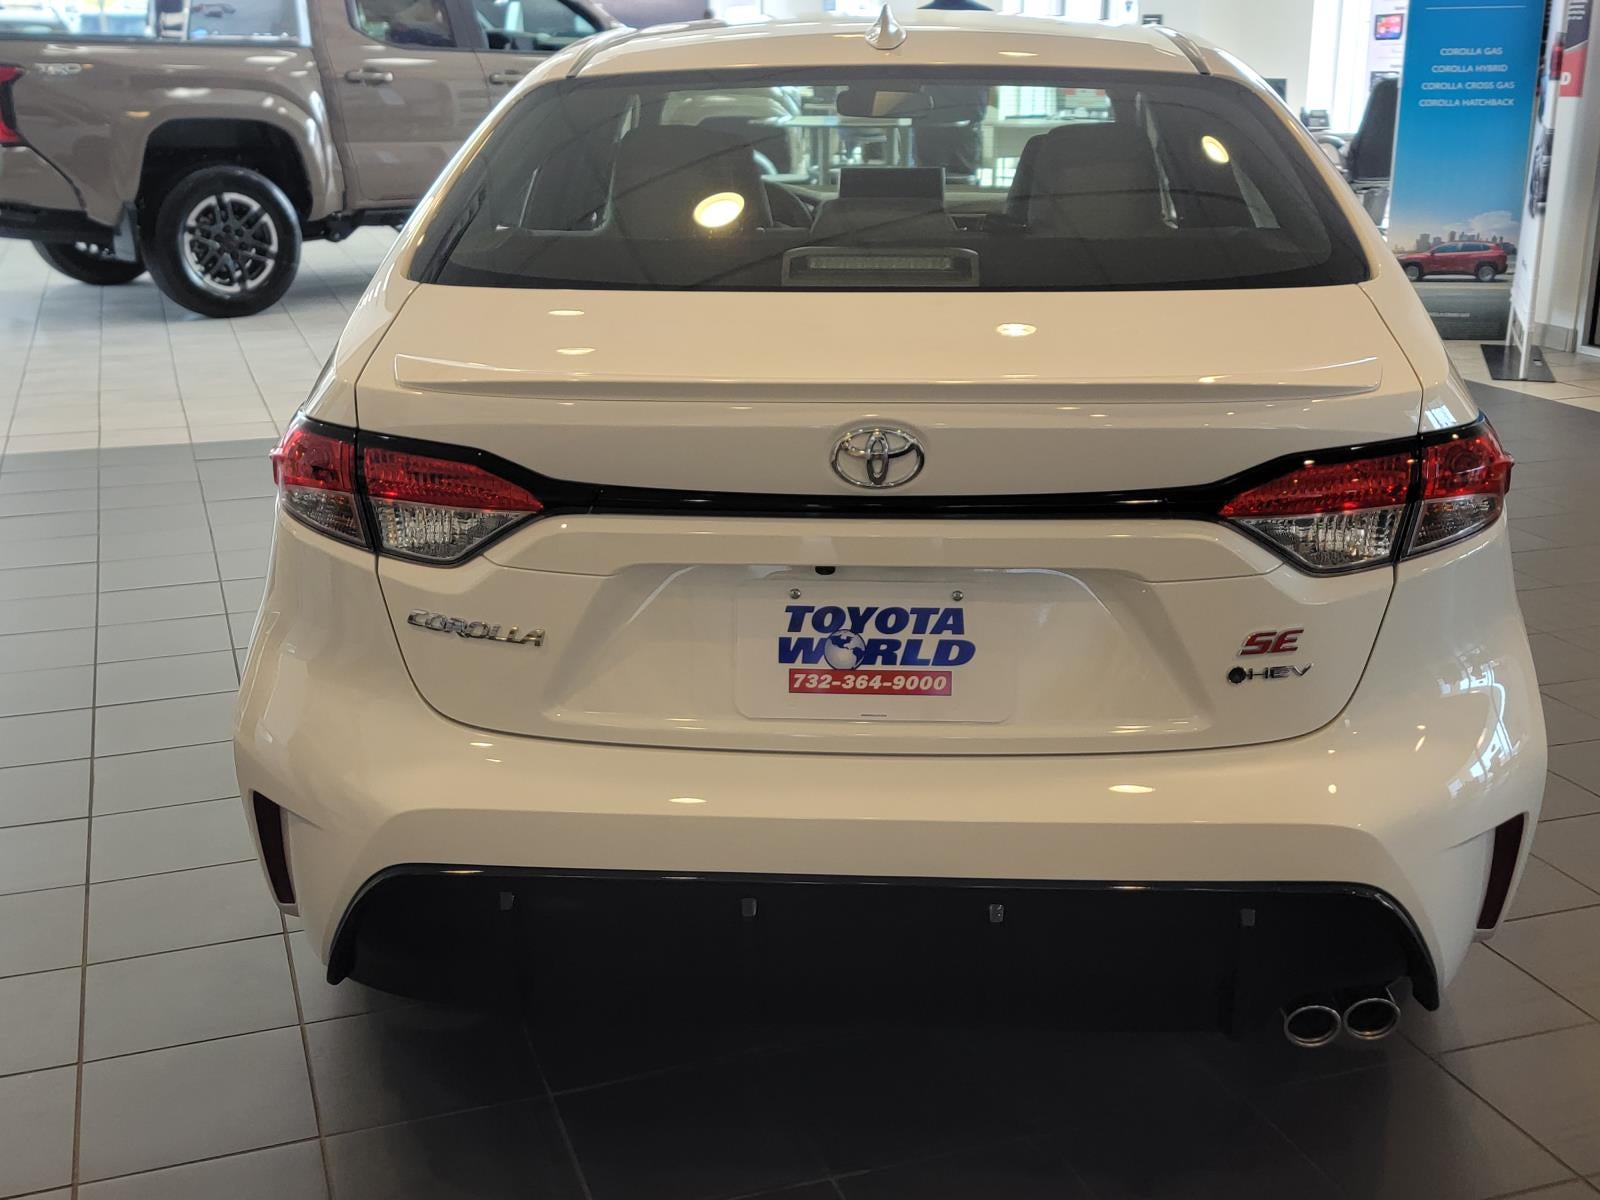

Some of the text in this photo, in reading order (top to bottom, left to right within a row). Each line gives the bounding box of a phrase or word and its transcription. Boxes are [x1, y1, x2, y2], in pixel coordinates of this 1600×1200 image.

[1440, 47, 1503, 56] COROLLA GAS
[1431, 64, 1508, 73] COROLLA HYBRID
[1421, 81, 1515, 90] COROLLA CROSS GAS
[1419, 98, 1514, 107] COROLLA HATCHBACK
[407, 608, 545, 647] COROLLA
[785, 606, 965, 635] TOYOTA
[778, 629, 976, 671] WORLD
[1239, 627, 1304, 656] SE
[793, 673, 947, 690] 732-364-9000
